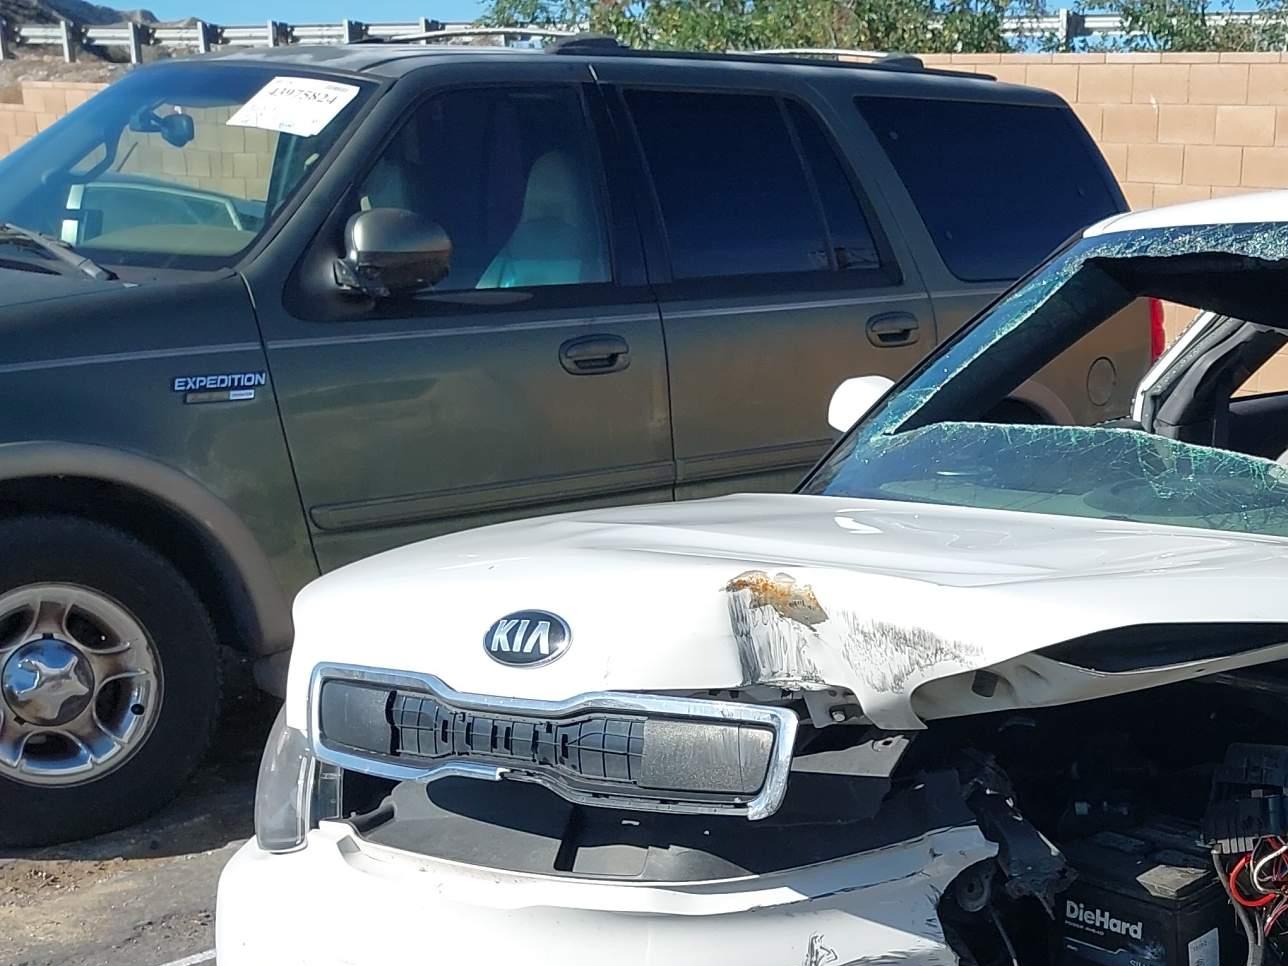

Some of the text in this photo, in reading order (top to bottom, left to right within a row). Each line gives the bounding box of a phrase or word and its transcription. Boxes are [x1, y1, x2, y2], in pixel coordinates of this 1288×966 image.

[174, 372, 266, 391] EXPEDITION
[491, 619, 550, 655] KIA
[1066, 899, 1143, 940] DieHard
